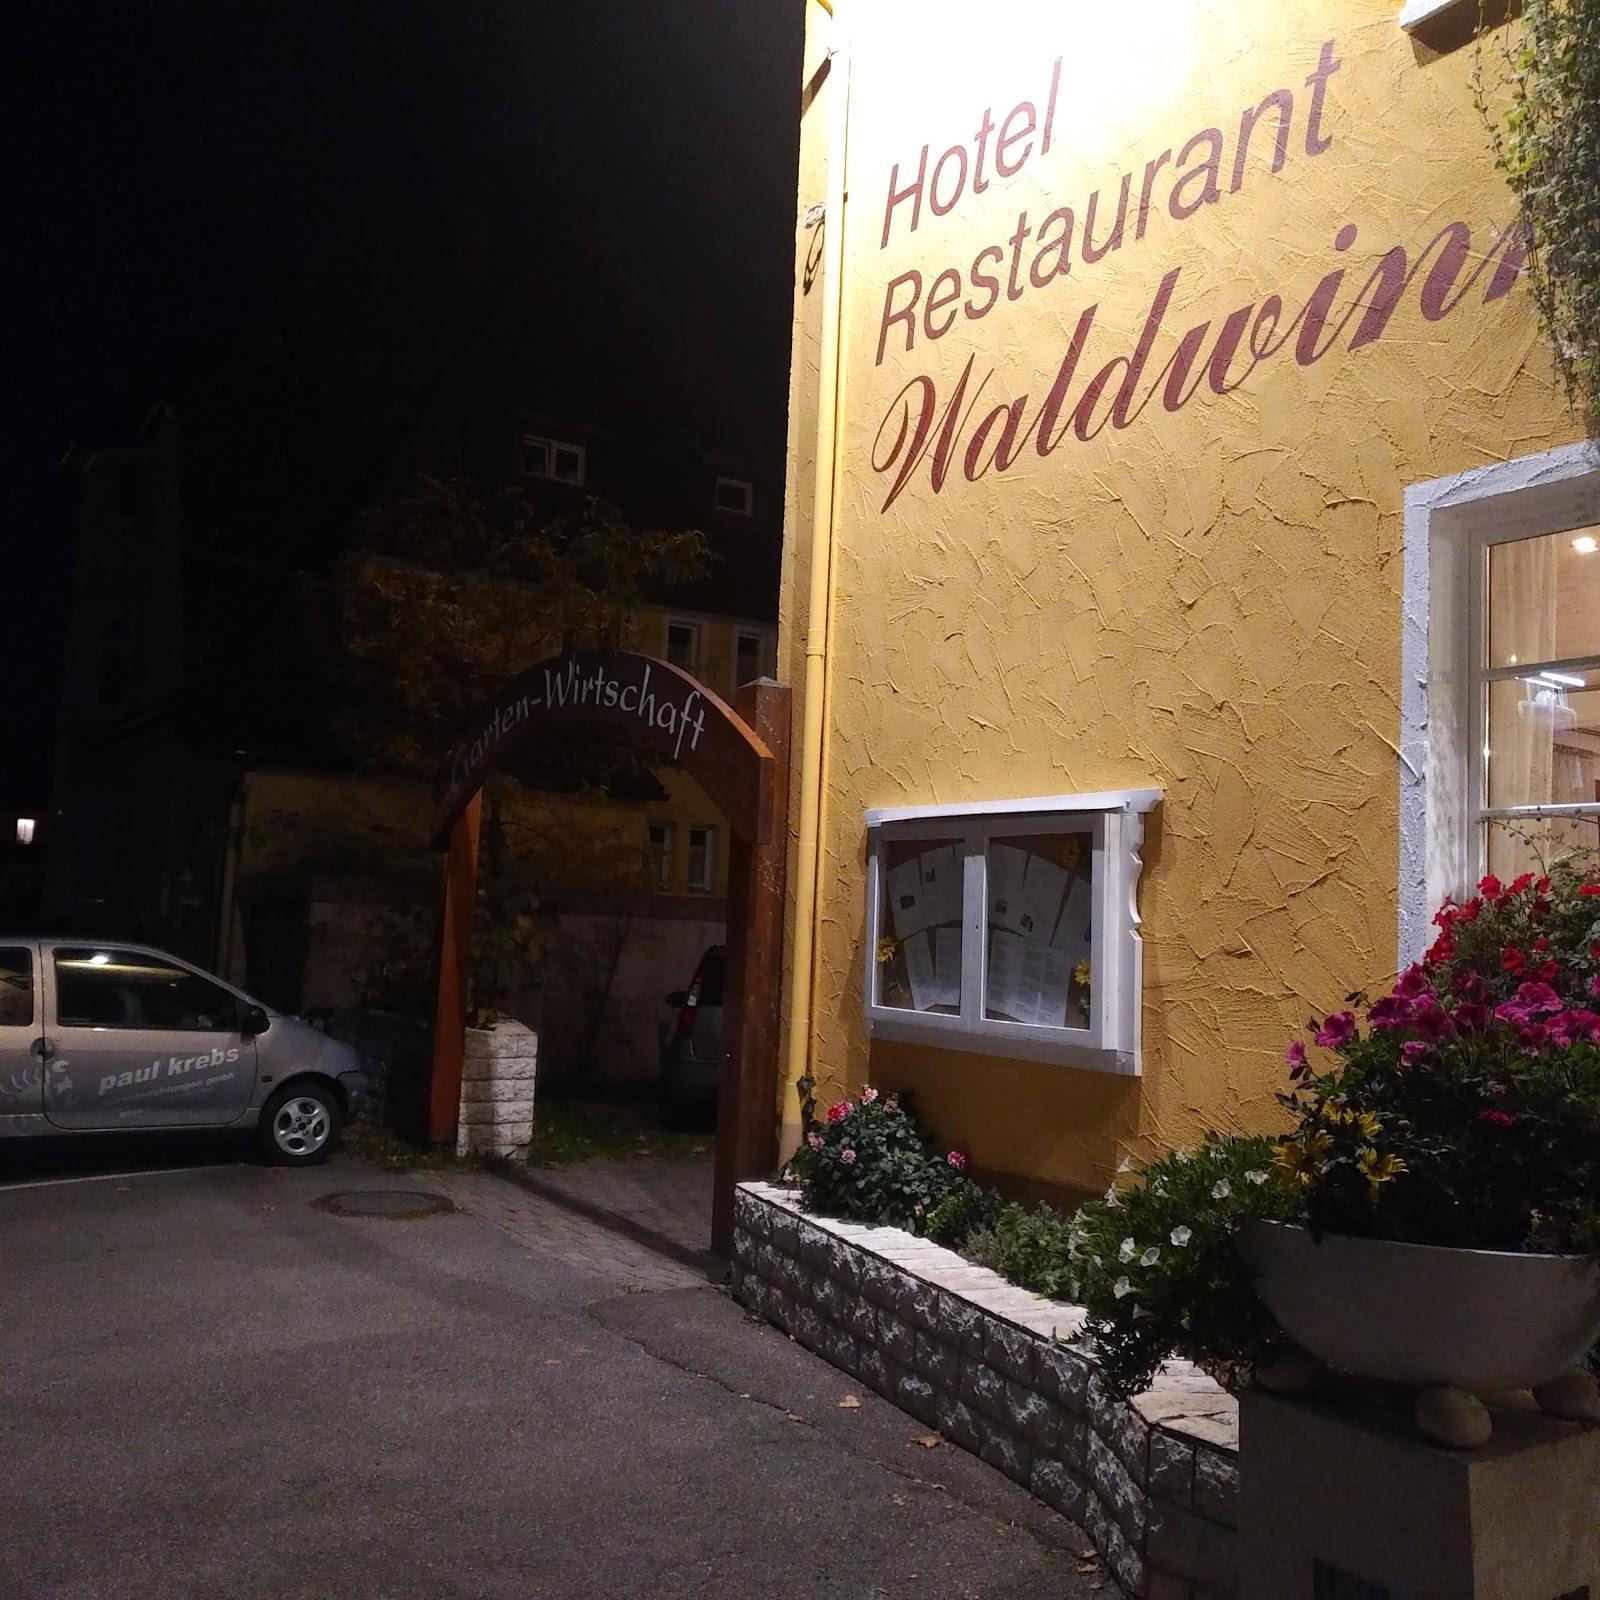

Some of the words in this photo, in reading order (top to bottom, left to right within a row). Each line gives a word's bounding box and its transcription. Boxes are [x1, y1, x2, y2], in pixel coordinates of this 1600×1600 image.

[875, 38, 1341, 366] Restaurant
[880, 56, 1063, 250] Hotel
[98, 1060, 160, 1096] paul
[167, 1048, 240, 1077] krebs
